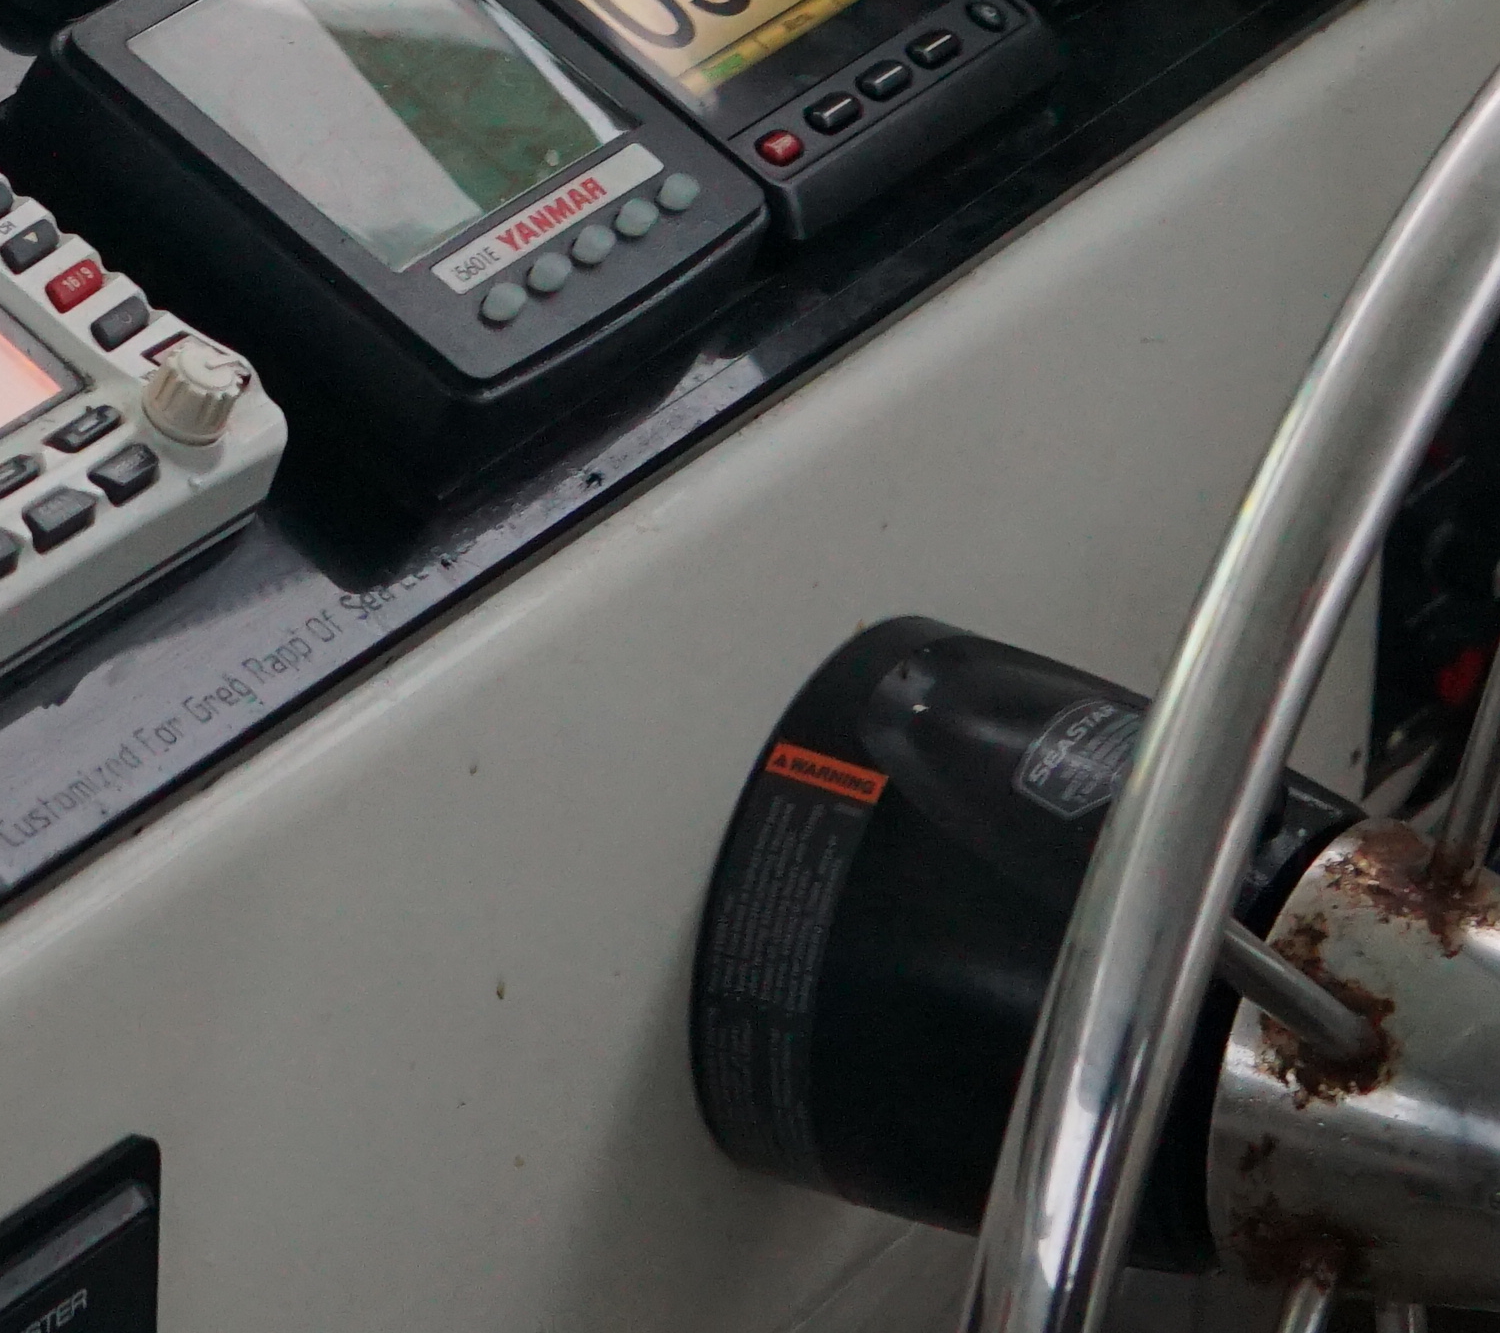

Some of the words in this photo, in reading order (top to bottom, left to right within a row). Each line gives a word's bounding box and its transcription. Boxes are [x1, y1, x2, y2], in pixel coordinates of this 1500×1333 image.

[495, 176, 608, 252] YANMAR
[62, 265, 94, 292] 16/9
[137, 717, 185, 770] For
[183, 670, 255, 724] Greg
[243, 633, 314, 681] Rapp
[304, 608, 342, 645] Of
[790, 757, 876, 795] WARNING
